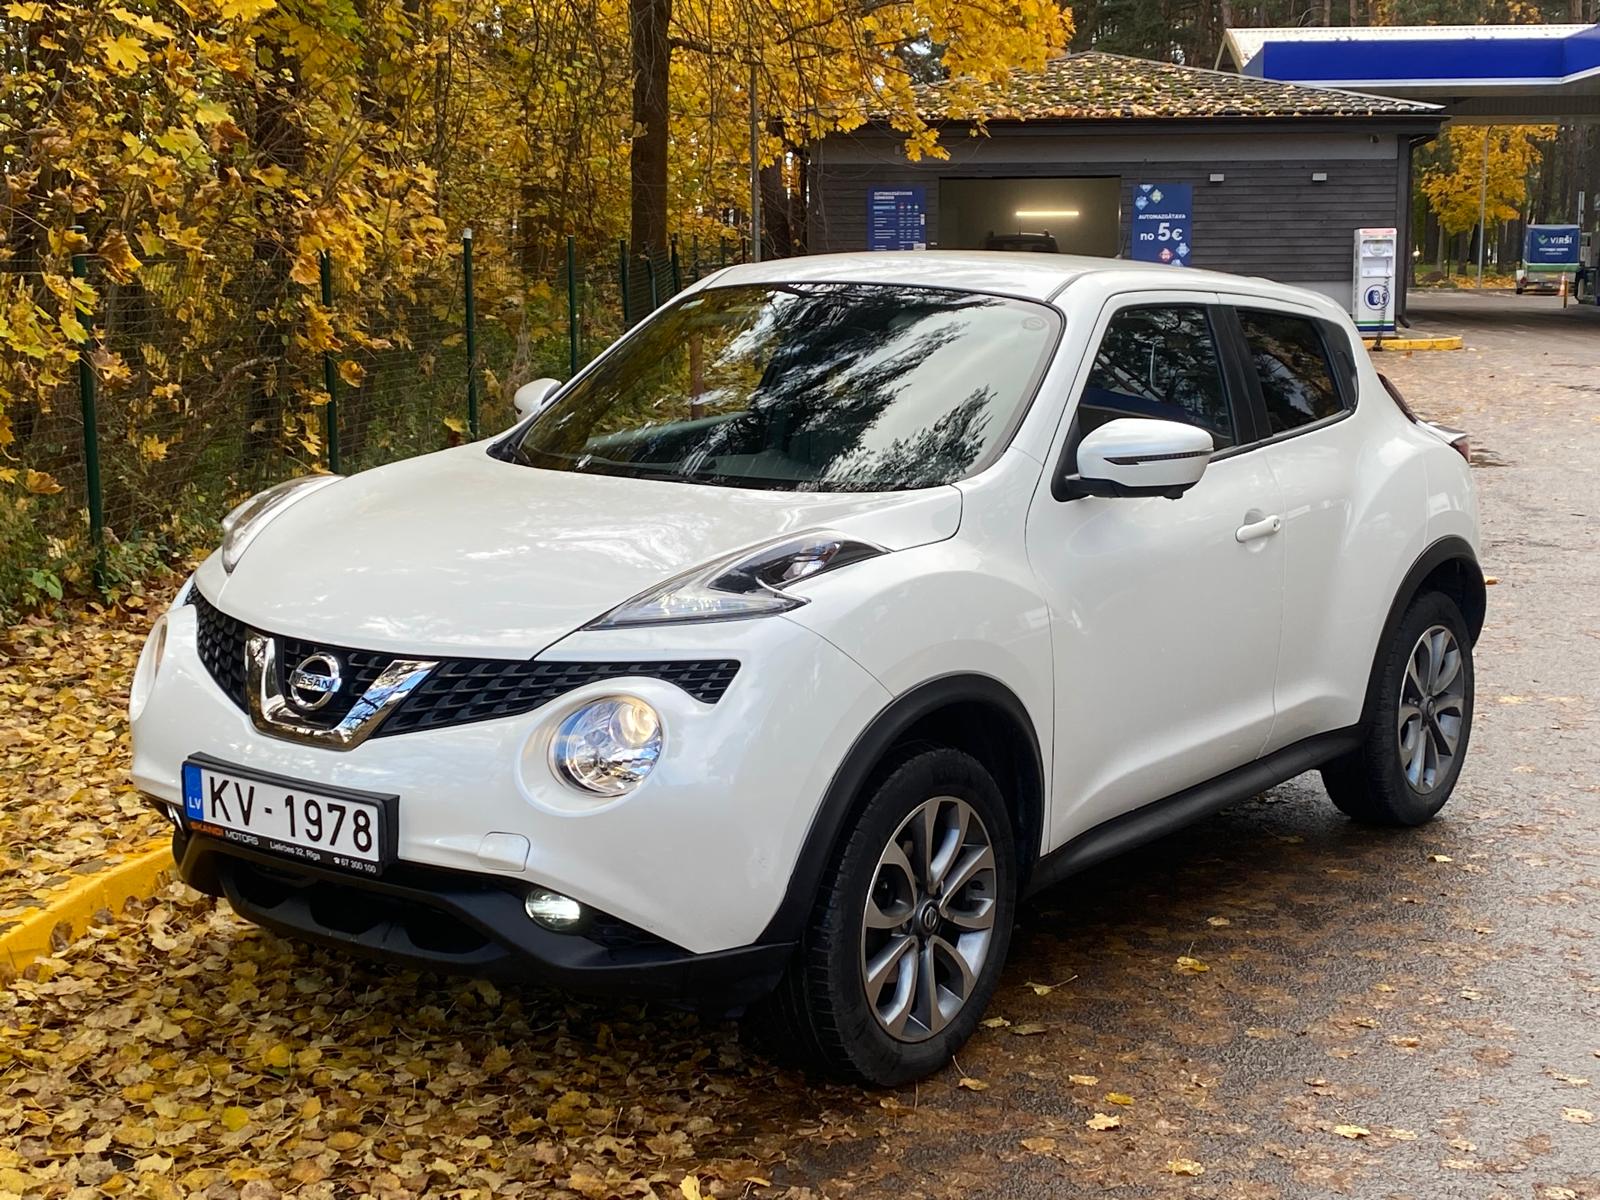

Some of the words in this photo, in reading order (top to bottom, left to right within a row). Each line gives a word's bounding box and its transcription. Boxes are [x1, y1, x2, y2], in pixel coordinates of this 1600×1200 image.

[188, 796, 202, 810] LV
[209, 776, 373, 853] KV-1978
[225, 830, 259, 846] MOTORS
